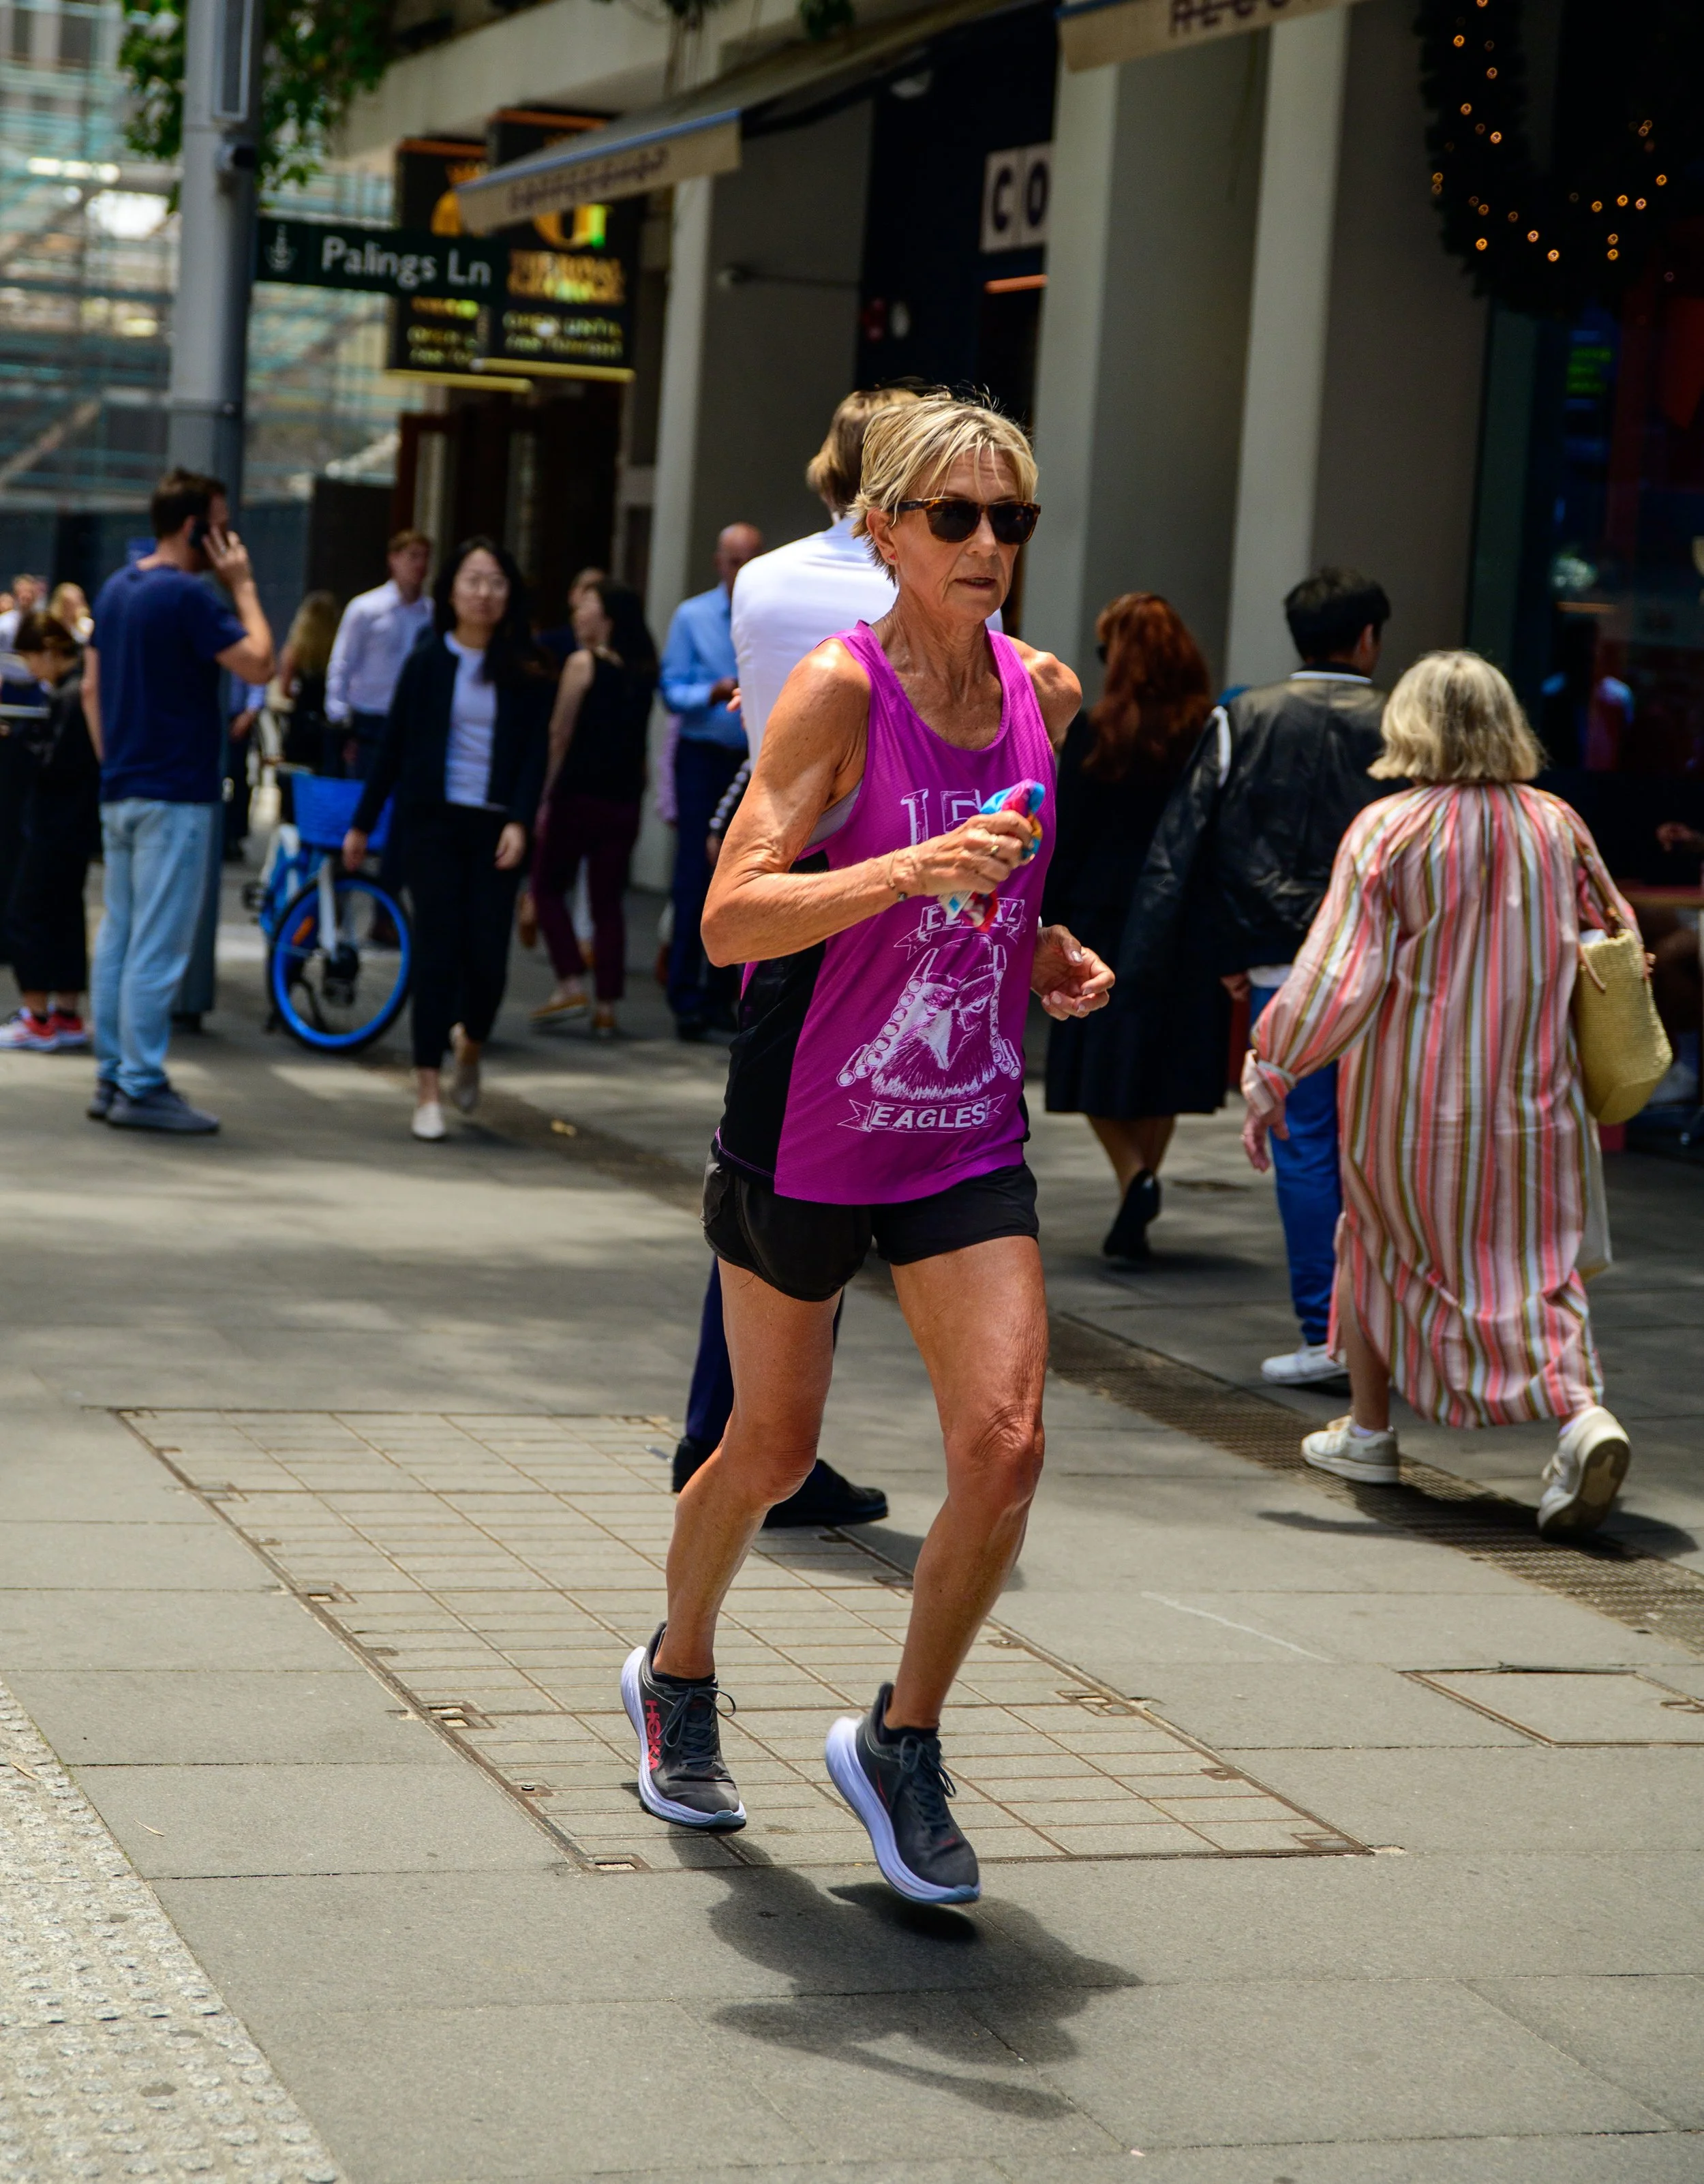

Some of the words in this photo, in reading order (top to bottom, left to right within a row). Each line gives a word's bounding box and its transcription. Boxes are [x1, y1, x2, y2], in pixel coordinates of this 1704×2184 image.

[321, 235, 438, 291] Palings
[447, 247, 493, 288] Ln
[870, 1102, 986, 1129] EAGLES
[645, 1699, 662, 1773] HOKA
